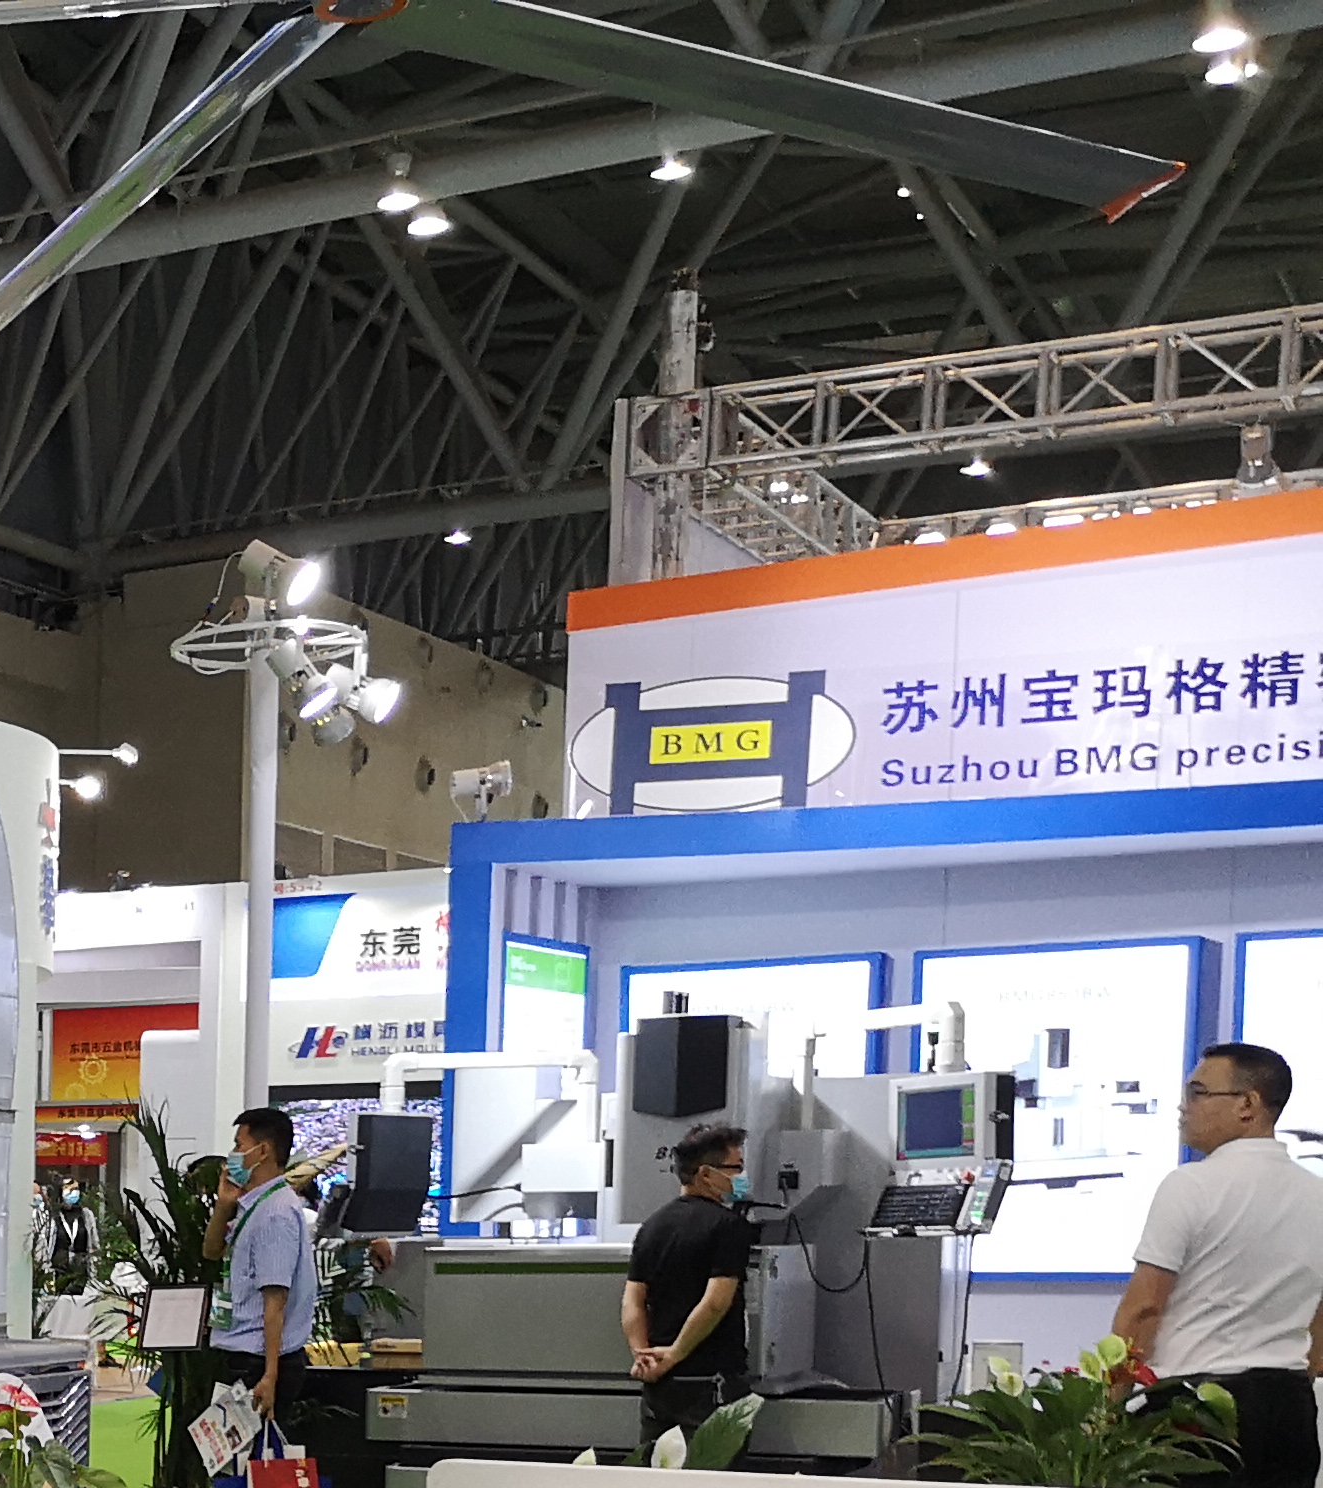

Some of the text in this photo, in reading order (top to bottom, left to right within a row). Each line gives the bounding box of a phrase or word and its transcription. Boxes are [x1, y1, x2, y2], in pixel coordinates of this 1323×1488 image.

[882, 650, 1323, 735] 苏州宝玛格精
[660, 729, 760, 756] BMG
[881, 754, 1039, 788] Suzhou
[1055, 742, 1159, 777] BMG
[360, 926, 421, 957] 东莞
